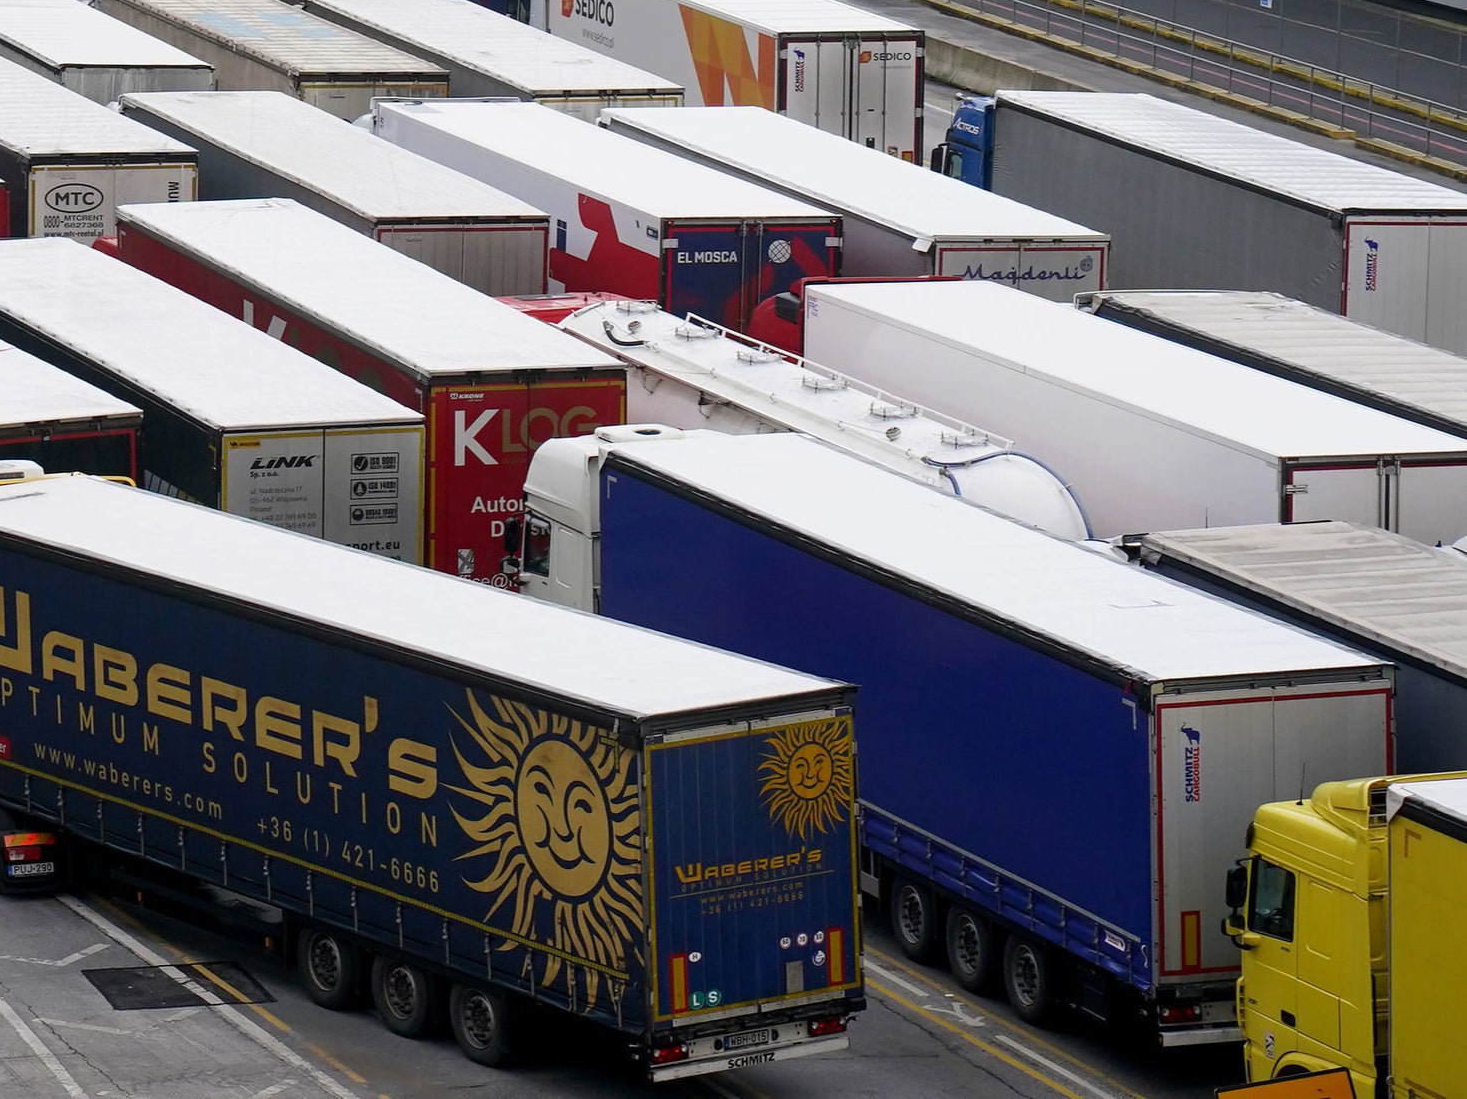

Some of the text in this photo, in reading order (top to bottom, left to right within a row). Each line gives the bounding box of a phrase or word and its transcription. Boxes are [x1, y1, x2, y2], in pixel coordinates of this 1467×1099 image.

[873, 52, 912, 61] SEDICO
[952, 117, 980, 135] ACTROS
[54, 191, 96, 206] MTC
[64, 214, 104, 222] MTCRENT
[677, 251, 738, 264] EL MOSCA
[471, 496, 526, 514] Auto
[1185, 747, 1193, 803] SCHMITZ
[203, 741, 439, 850] SOLUTION
[34, 741, 440, 895] www.waberers.com +36 (1) 421-6666
[681, 864, 823, 893] OPTIMUM SOLUTION
[701, 881, 804, 905] www.waberers.com
[750, 891, 805, 908] 421-6666
[693, 994, 700, 1007] L
[708, 991, 719, 1003] S
[727, 1052, 776, 1069] SCHMITZ
